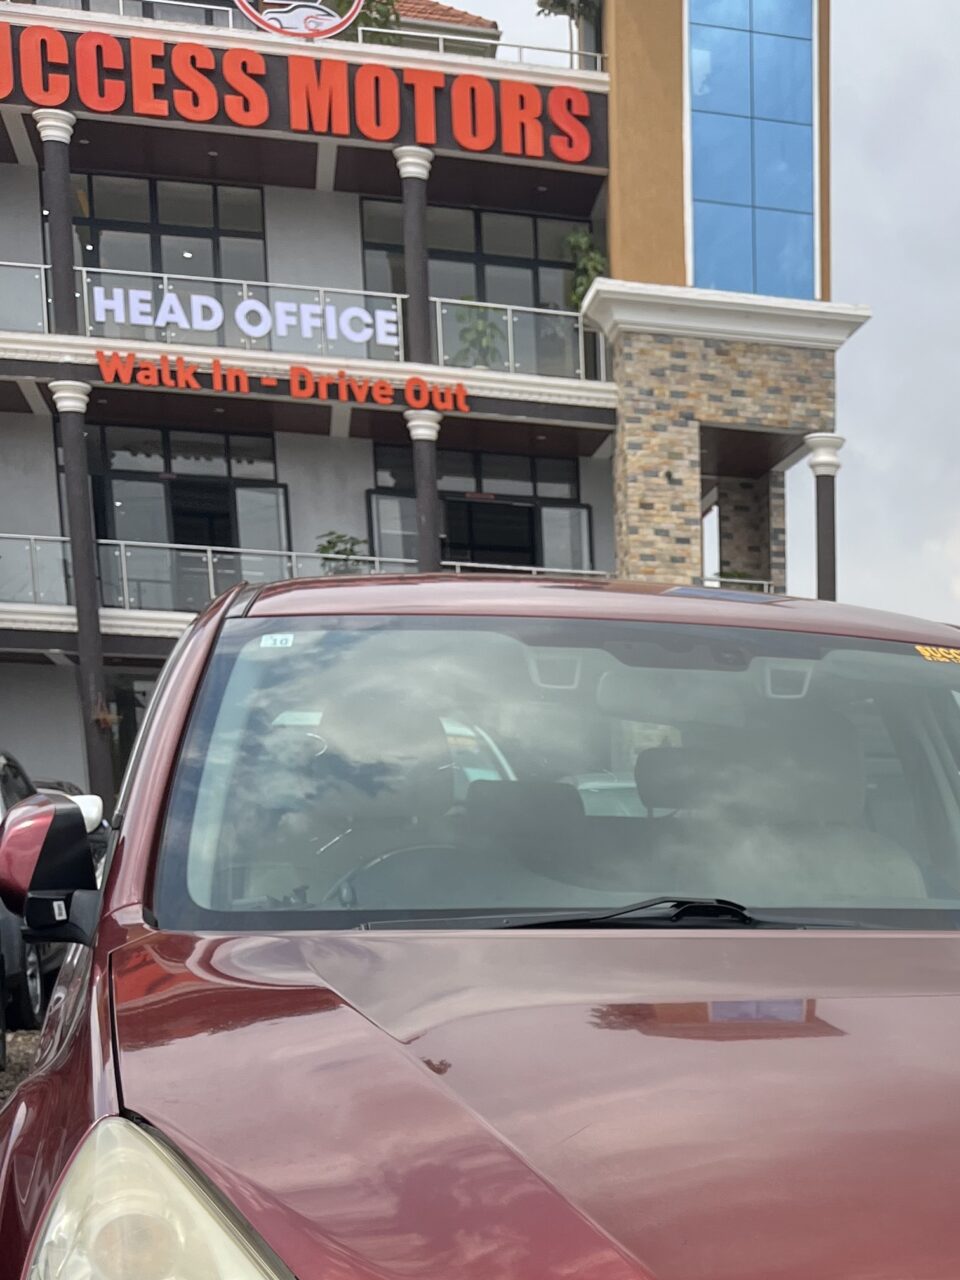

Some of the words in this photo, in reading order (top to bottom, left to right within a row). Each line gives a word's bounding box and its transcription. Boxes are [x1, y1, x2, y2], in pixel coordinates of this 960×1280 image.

[0, 22, 270, 127] CCESS
[288, 55, 592, 163] MOTORS
[93, 286, 224, 332] HEAD
[234, 299, 400, 347] OFFICE
[96, 350, 201, 390] Walk
[211, 358, 250, 393] In
[289, 365, 394, 405] Drive
[404, 376, 471, 412] Out
